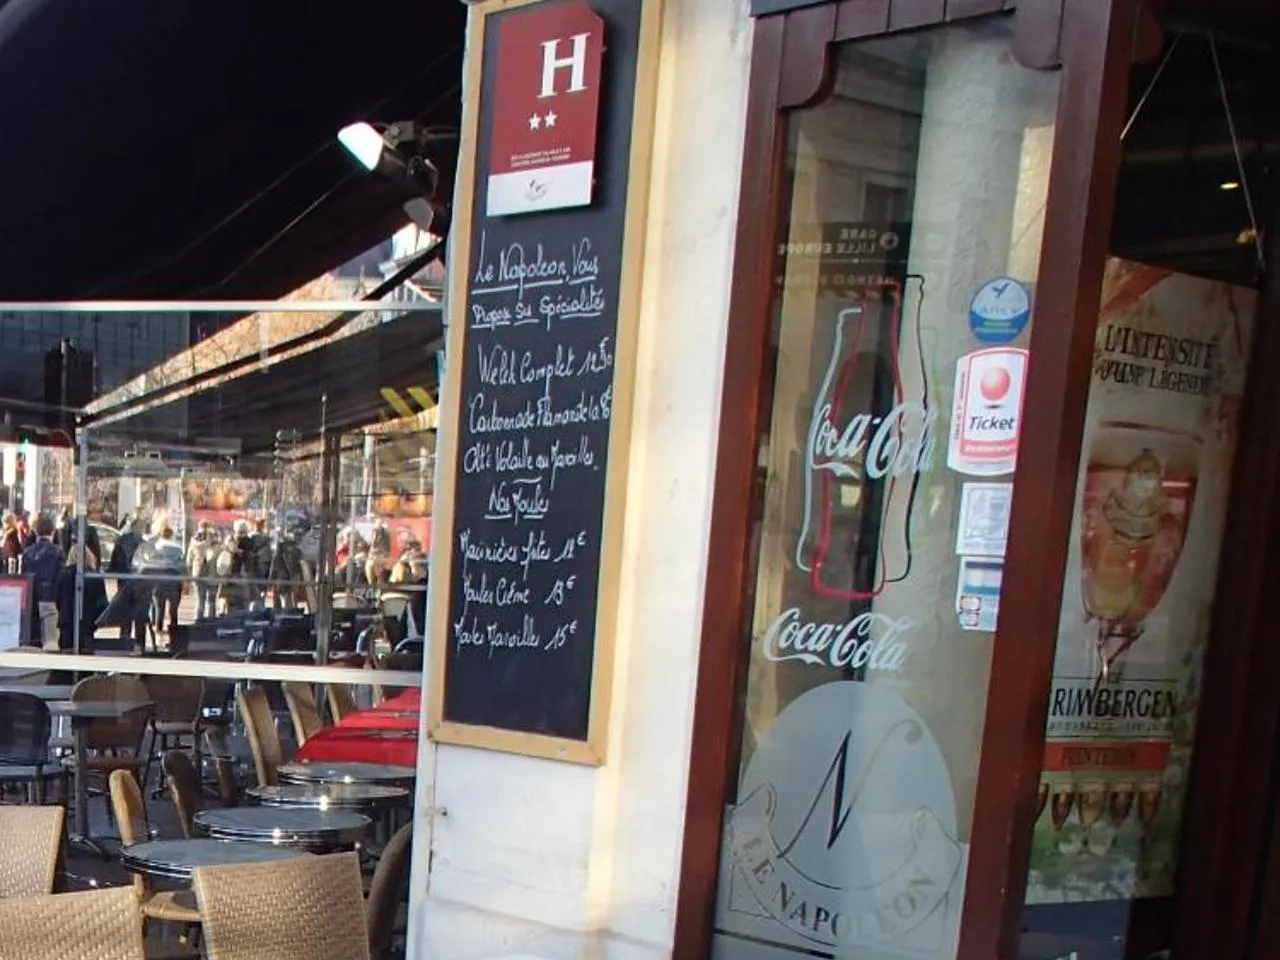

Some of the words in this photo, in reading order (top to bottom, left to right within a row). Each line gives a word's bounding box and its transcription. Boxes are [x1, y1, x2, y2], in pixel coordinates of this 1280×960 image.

[537, 32, 591, 98] H
[475, 229, 495, 283] Le
[572, 237, 599, 275] Vous
[519, 344, 575, 399] Complet
[811, 402, 938, 480] Coca-Cola
[969, 416, 1016, 431] Ticket
[489, 481, 511, 513] Nos
[763, 607, 917, 670] Coca-Cola
[1052, 687, 1179, 719] RIMBERGEN
[741, 836, 776, 885] LE
